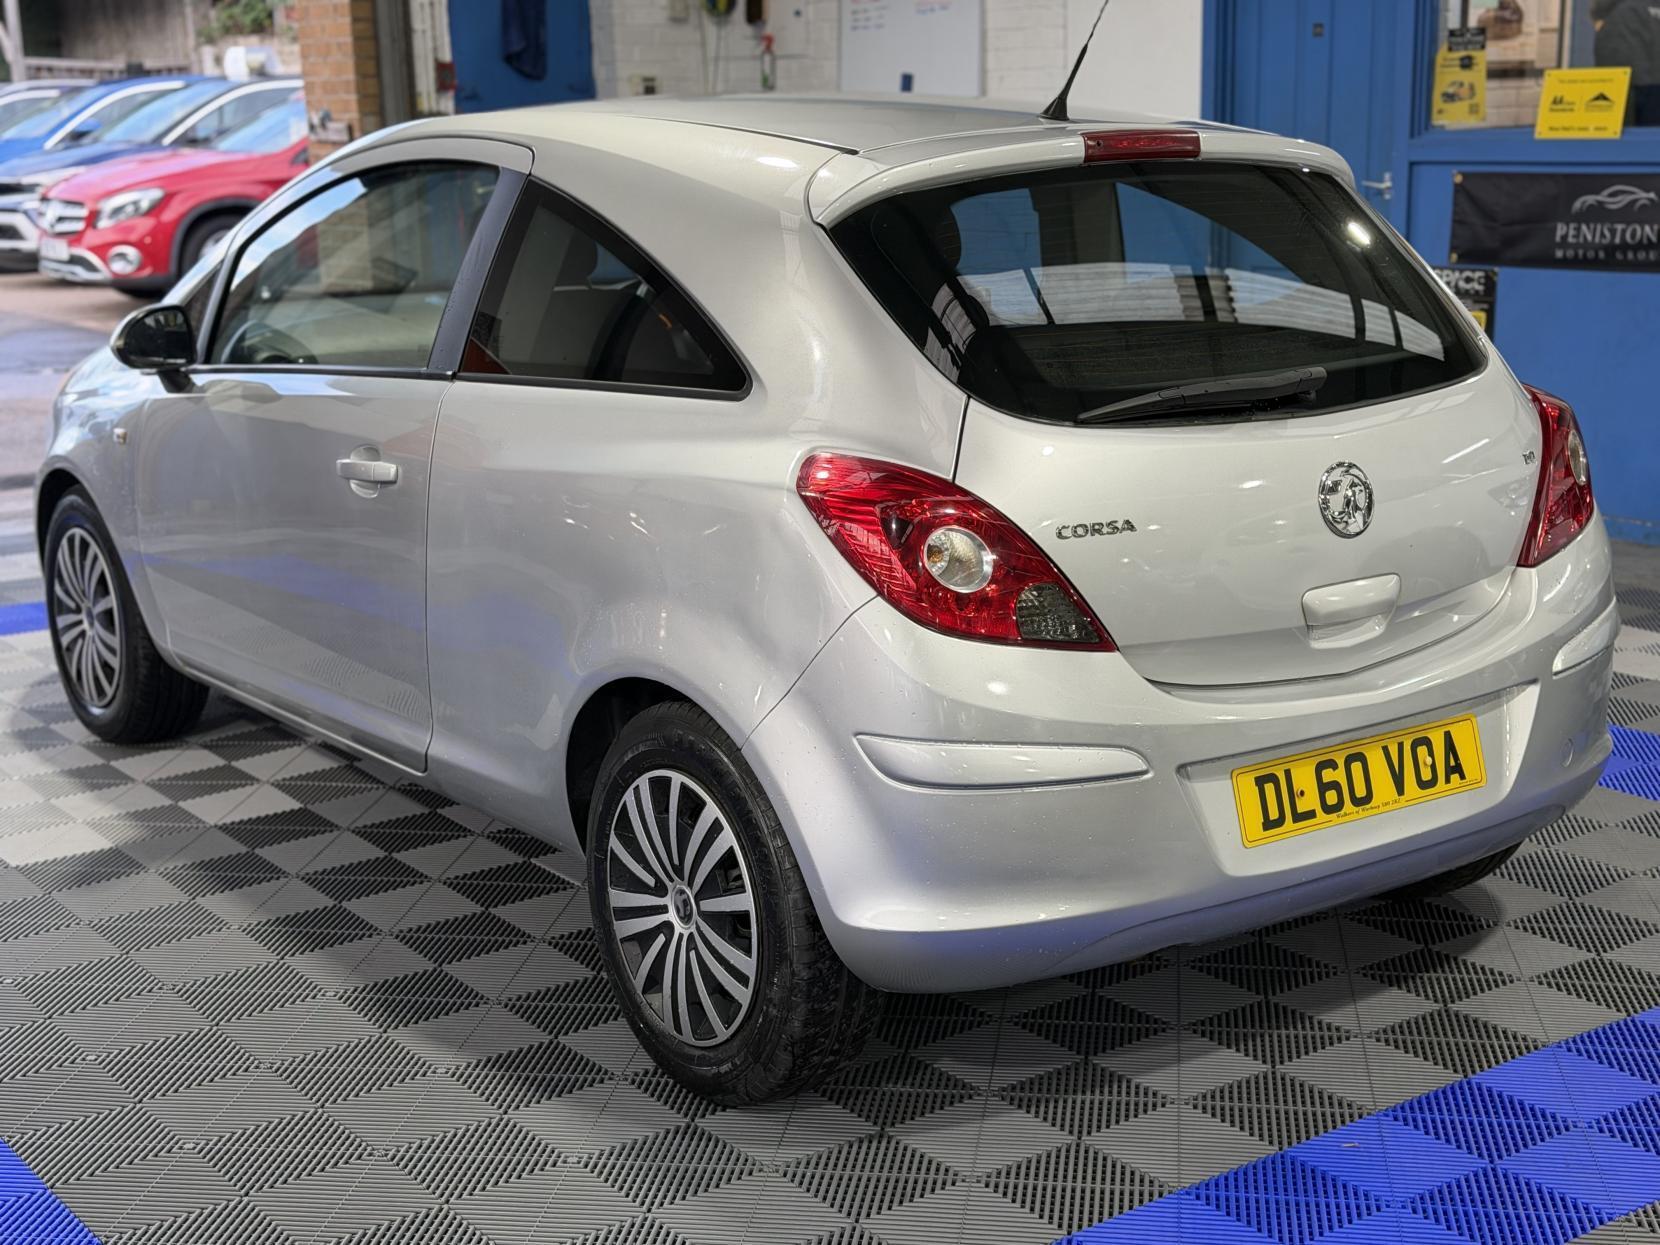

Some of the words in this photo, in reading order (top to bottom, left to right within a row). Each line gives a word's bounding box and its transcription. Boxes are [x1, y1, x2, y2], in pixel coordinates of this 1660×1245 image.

[1554, 248, 1605, 259] MOTOR
[1055, 519, 1138, 540] CORSA
[1254, 751, 1374, 832] DL60
[1381, 729, 1467, 797] VOA
